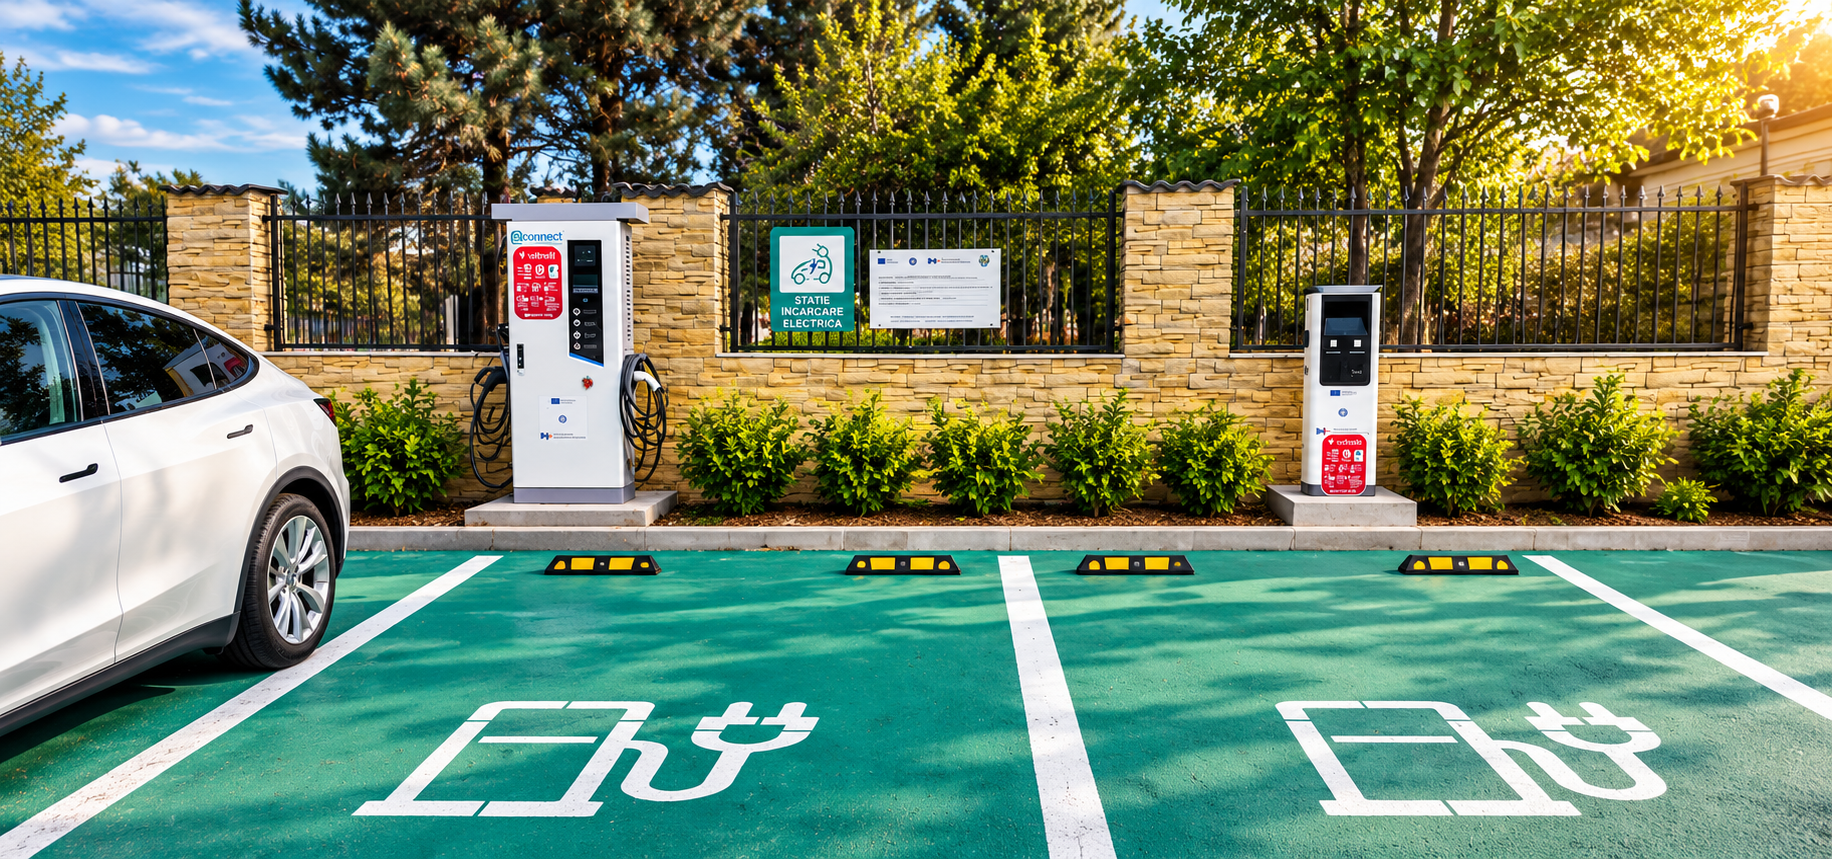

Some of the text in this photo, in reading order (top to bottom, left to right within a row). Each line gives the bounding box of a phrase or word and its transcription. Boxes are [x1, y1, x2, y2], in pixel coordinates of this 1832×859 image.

[794, 295, 830, 305] STATIE
[781, 307, 844, 316] INCARCARE
[783, 319, 843, 328] ELECTRICA
